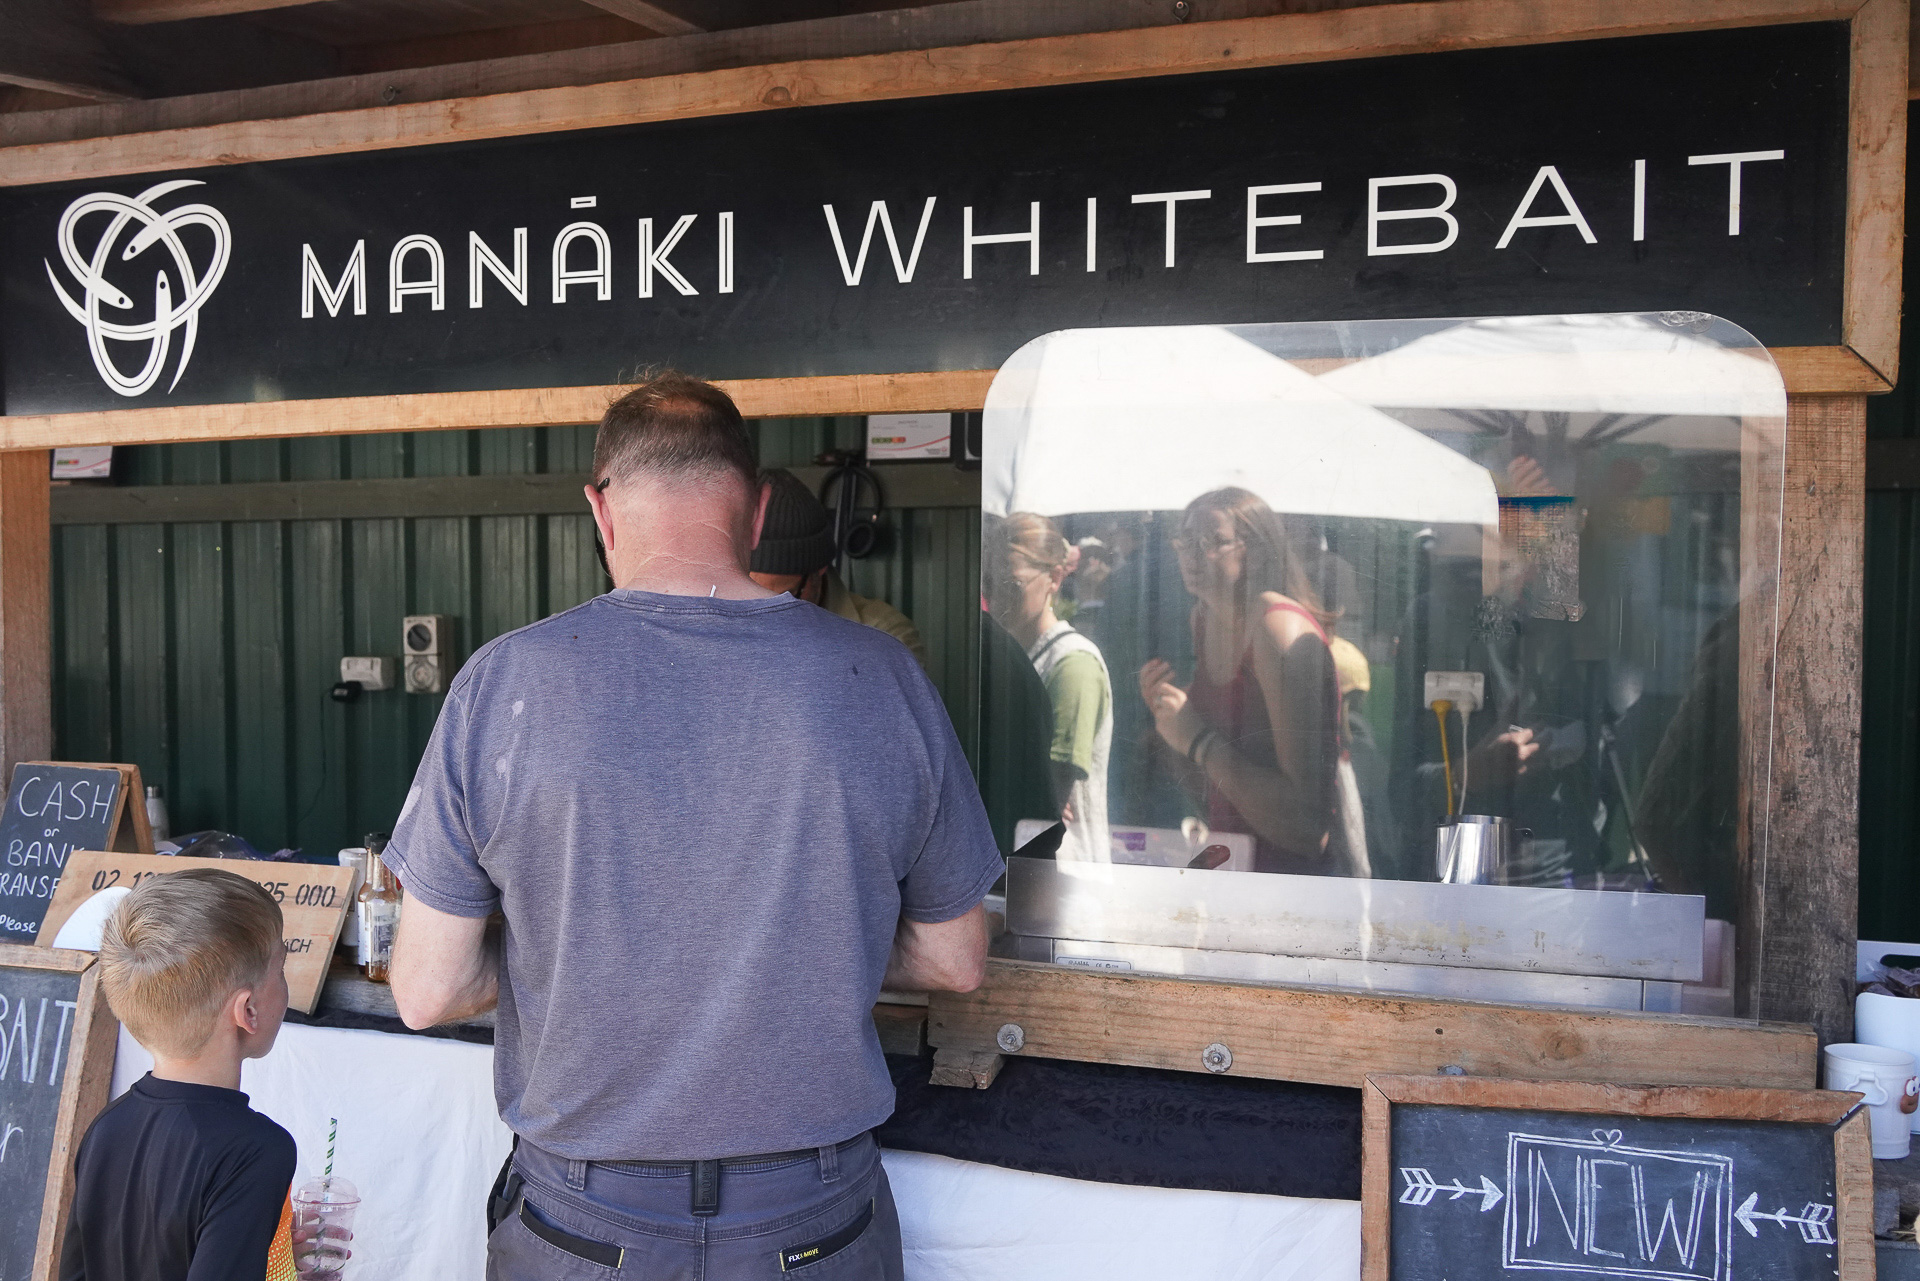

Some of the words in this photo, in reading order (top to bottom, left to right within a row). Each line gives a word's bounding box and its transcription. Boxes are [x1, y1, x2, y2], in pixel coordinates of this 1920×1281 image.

[301, 195, 734, 318] MANĀKI
[822, 149, 1786, 288] WHITEBAIT
[19, 776, 115, 824] CASH
[44, 828, 60, 837] or
[7, 839, 85, 868] BAN
[0, 872, 61, 899] RANSF
[92, 869, 121, 891] 02
[295, 884, 336, 907] 000
[1526, 1148, 1709, 1270] NEW
[803, 1247, 819, 1258] MOVE
